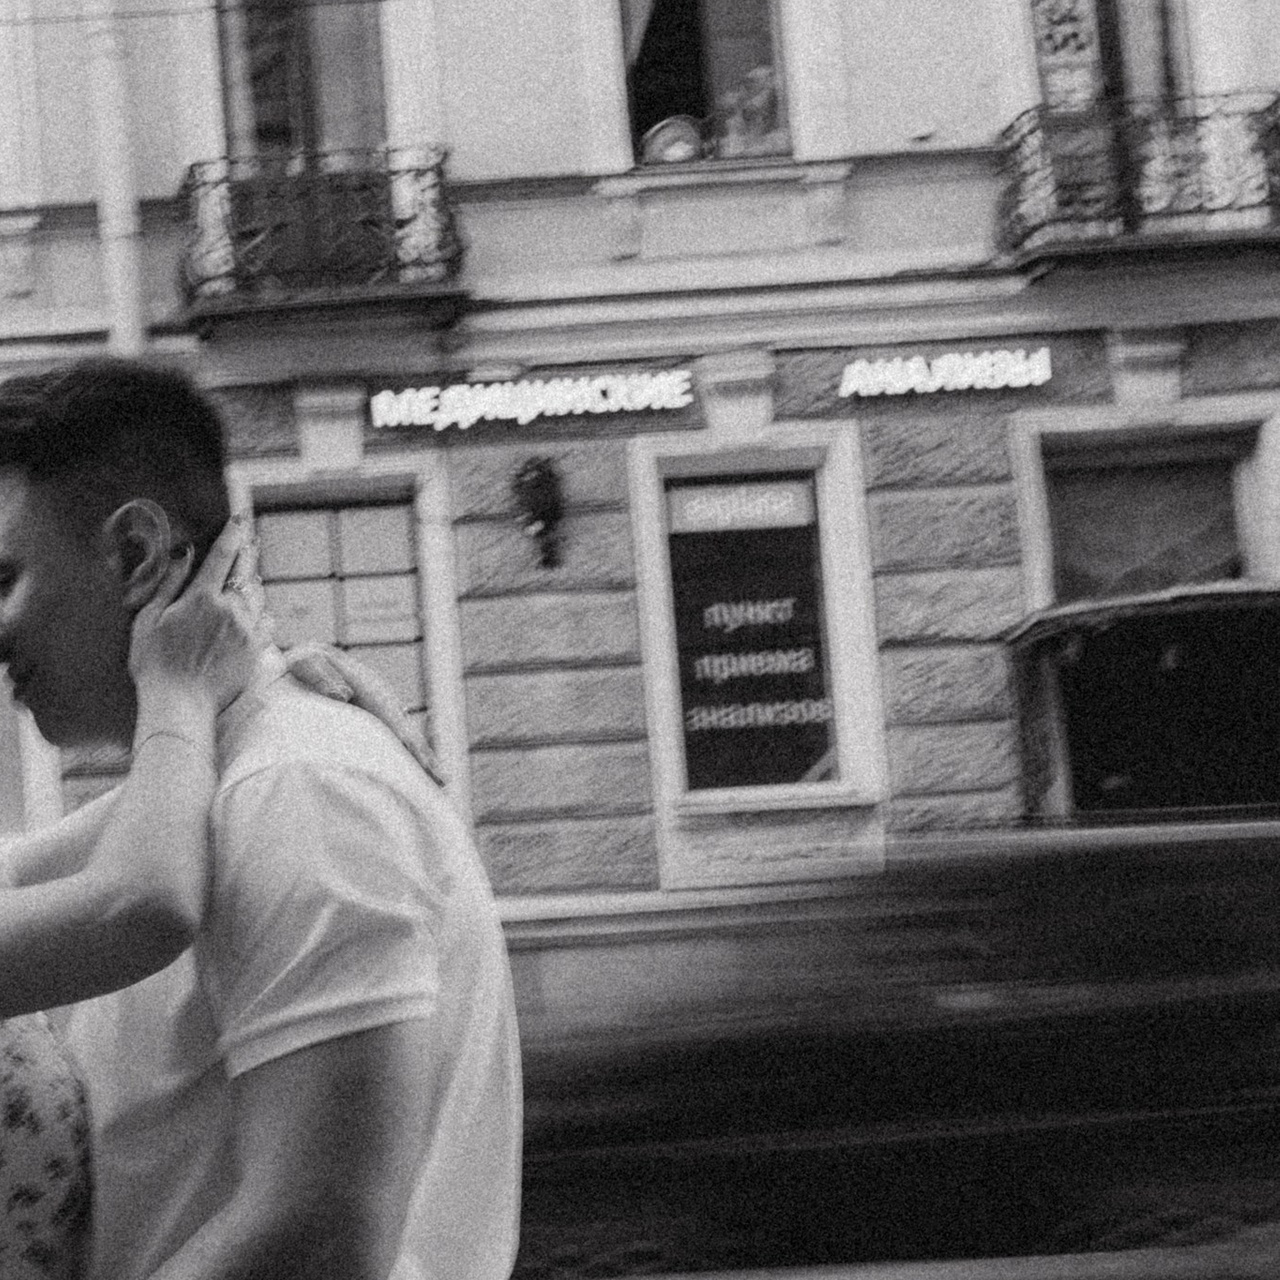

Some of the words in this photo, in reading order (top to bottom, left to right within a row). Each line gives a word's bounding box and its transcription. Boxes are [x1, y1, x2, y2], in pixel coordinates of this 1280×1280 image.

[371, 370, 694, 431] МЕДИЦИНСКИЕ
[838, 346, 1053, 398] АНАЛИЗЫ
[703, 597, 796, 633] пункт
